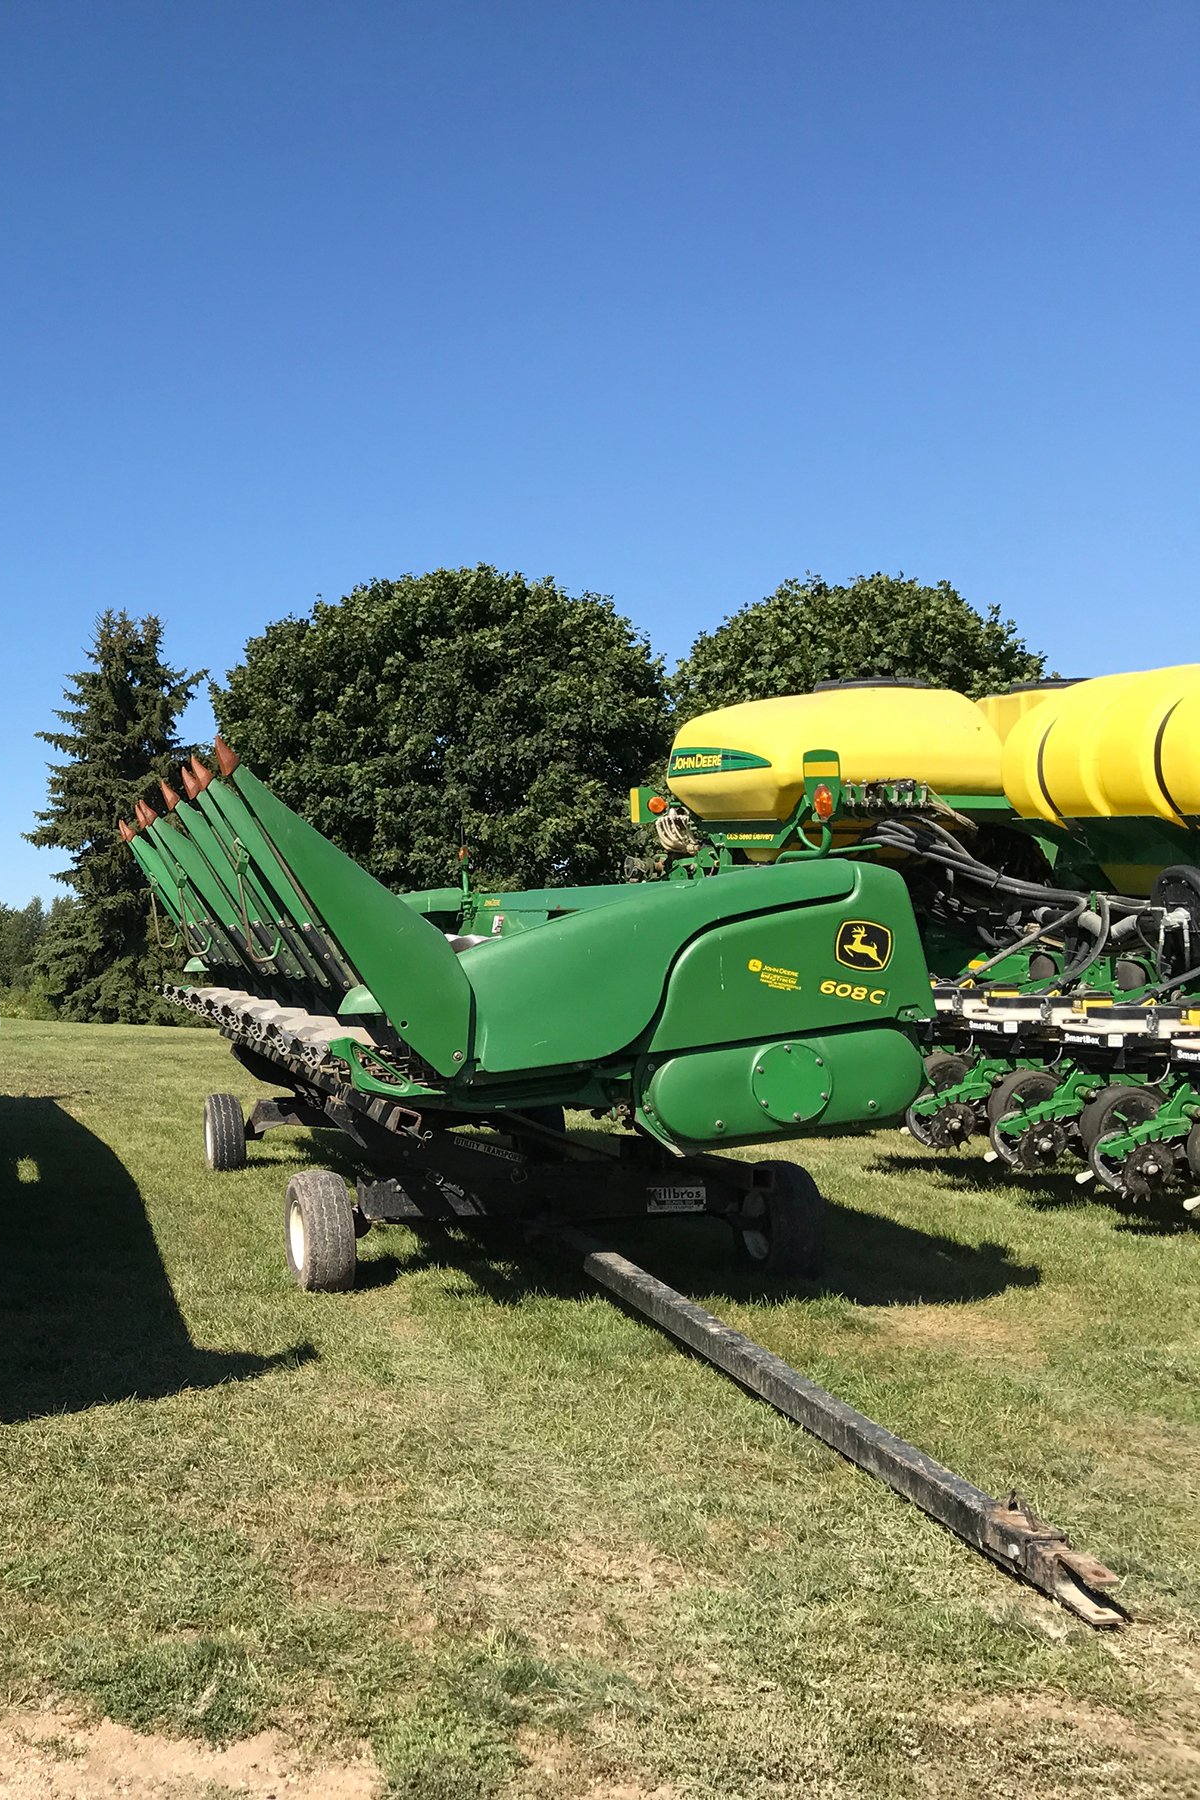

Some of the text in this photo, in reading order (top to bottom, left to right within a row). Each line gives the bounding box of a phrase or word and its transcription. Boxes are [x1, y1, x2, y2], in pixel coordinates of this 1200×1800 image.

[672, 754, 723, 770] JOHN DEERE
[968, 1020, 998, 1032] SmartBox
[1064, 1033, 1100, 1046] SmartBox
[456, 1137, 480, 1150] UTILITY
[647, 1187, 701, 1205] Killbros
